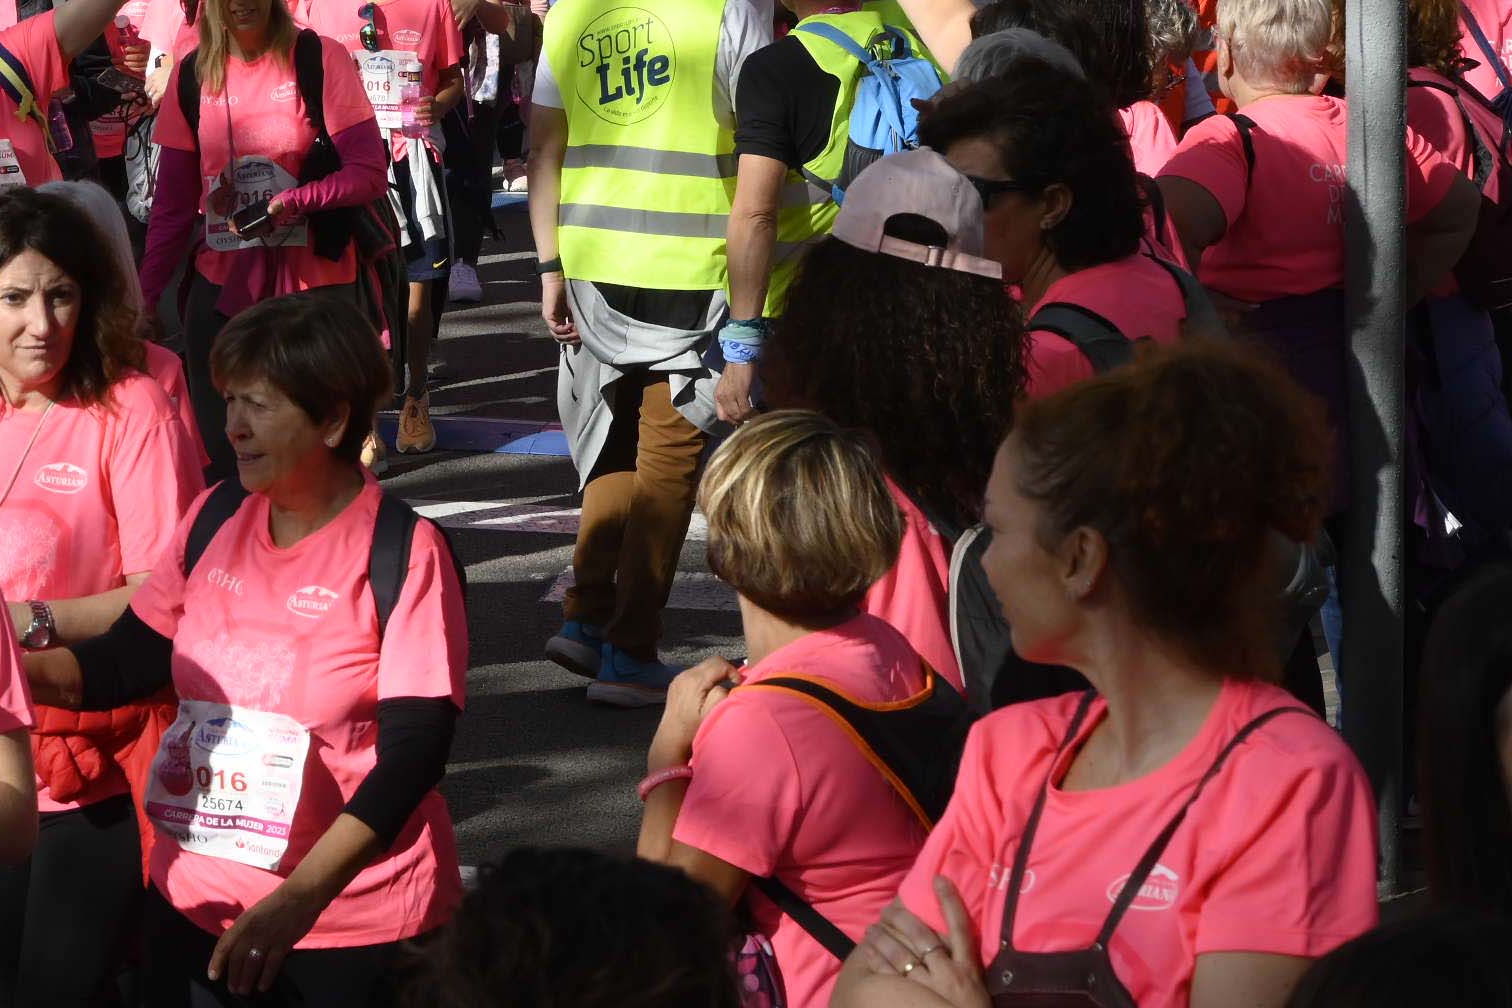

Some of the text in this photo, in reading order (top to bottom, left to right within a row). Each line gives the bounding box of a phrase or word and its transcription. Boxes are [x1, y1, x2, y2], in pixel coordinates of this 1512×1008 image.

[579, 17, 654, 68] Sport
[595, 48, 671, 106] Life
[196, 766, 248, 792] 016
[202, 795, 244, 811] 25674
[207, 817, 219, 826] DE
[220, 818, 234, 827] LA
[236, 819, 265, 831] MUJER
[266, 824, 287, 836] 2023
